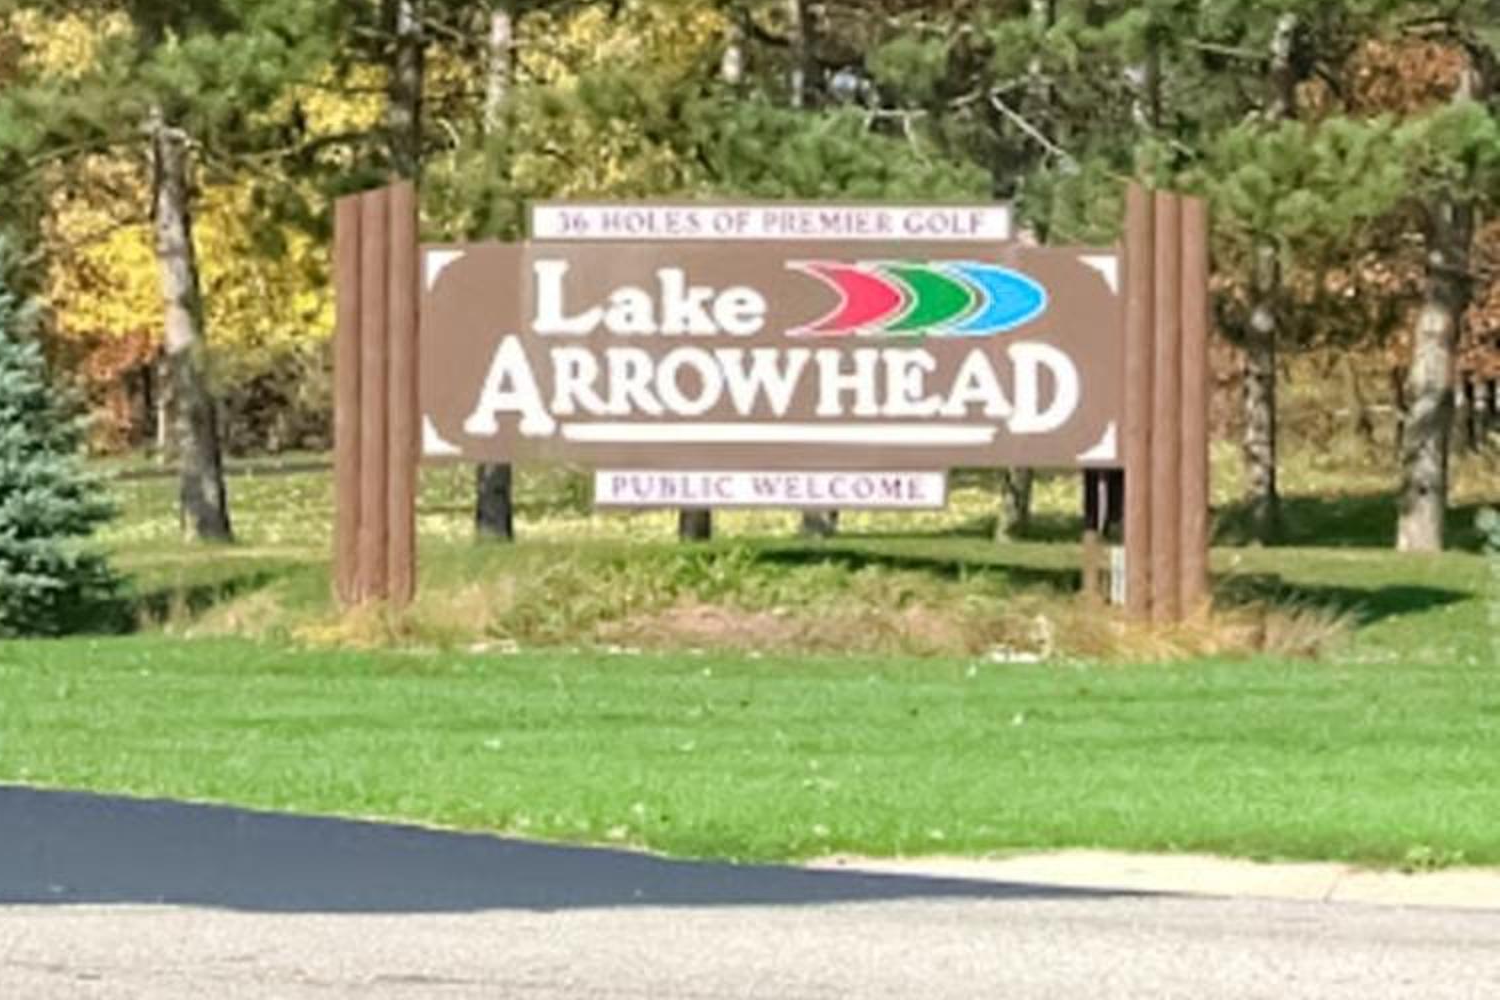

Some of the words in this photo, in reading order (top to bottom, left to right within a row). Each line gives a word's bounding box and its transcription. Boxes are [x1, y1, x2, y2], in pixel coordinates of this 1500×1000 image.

[601, 209, 700, 233] HOLES
[712, 209, 748, 233] OF
[762, 209, 893, 234] PREMIER
[903, 209, 986, 235] GOLF
[532, 259, 768, 335] Lake
[463, 335, 1080, 435] ARROWHEAD
[611, 475, 734, 499] PUBLIC
[752, 475, 927, 500] WELCOME
